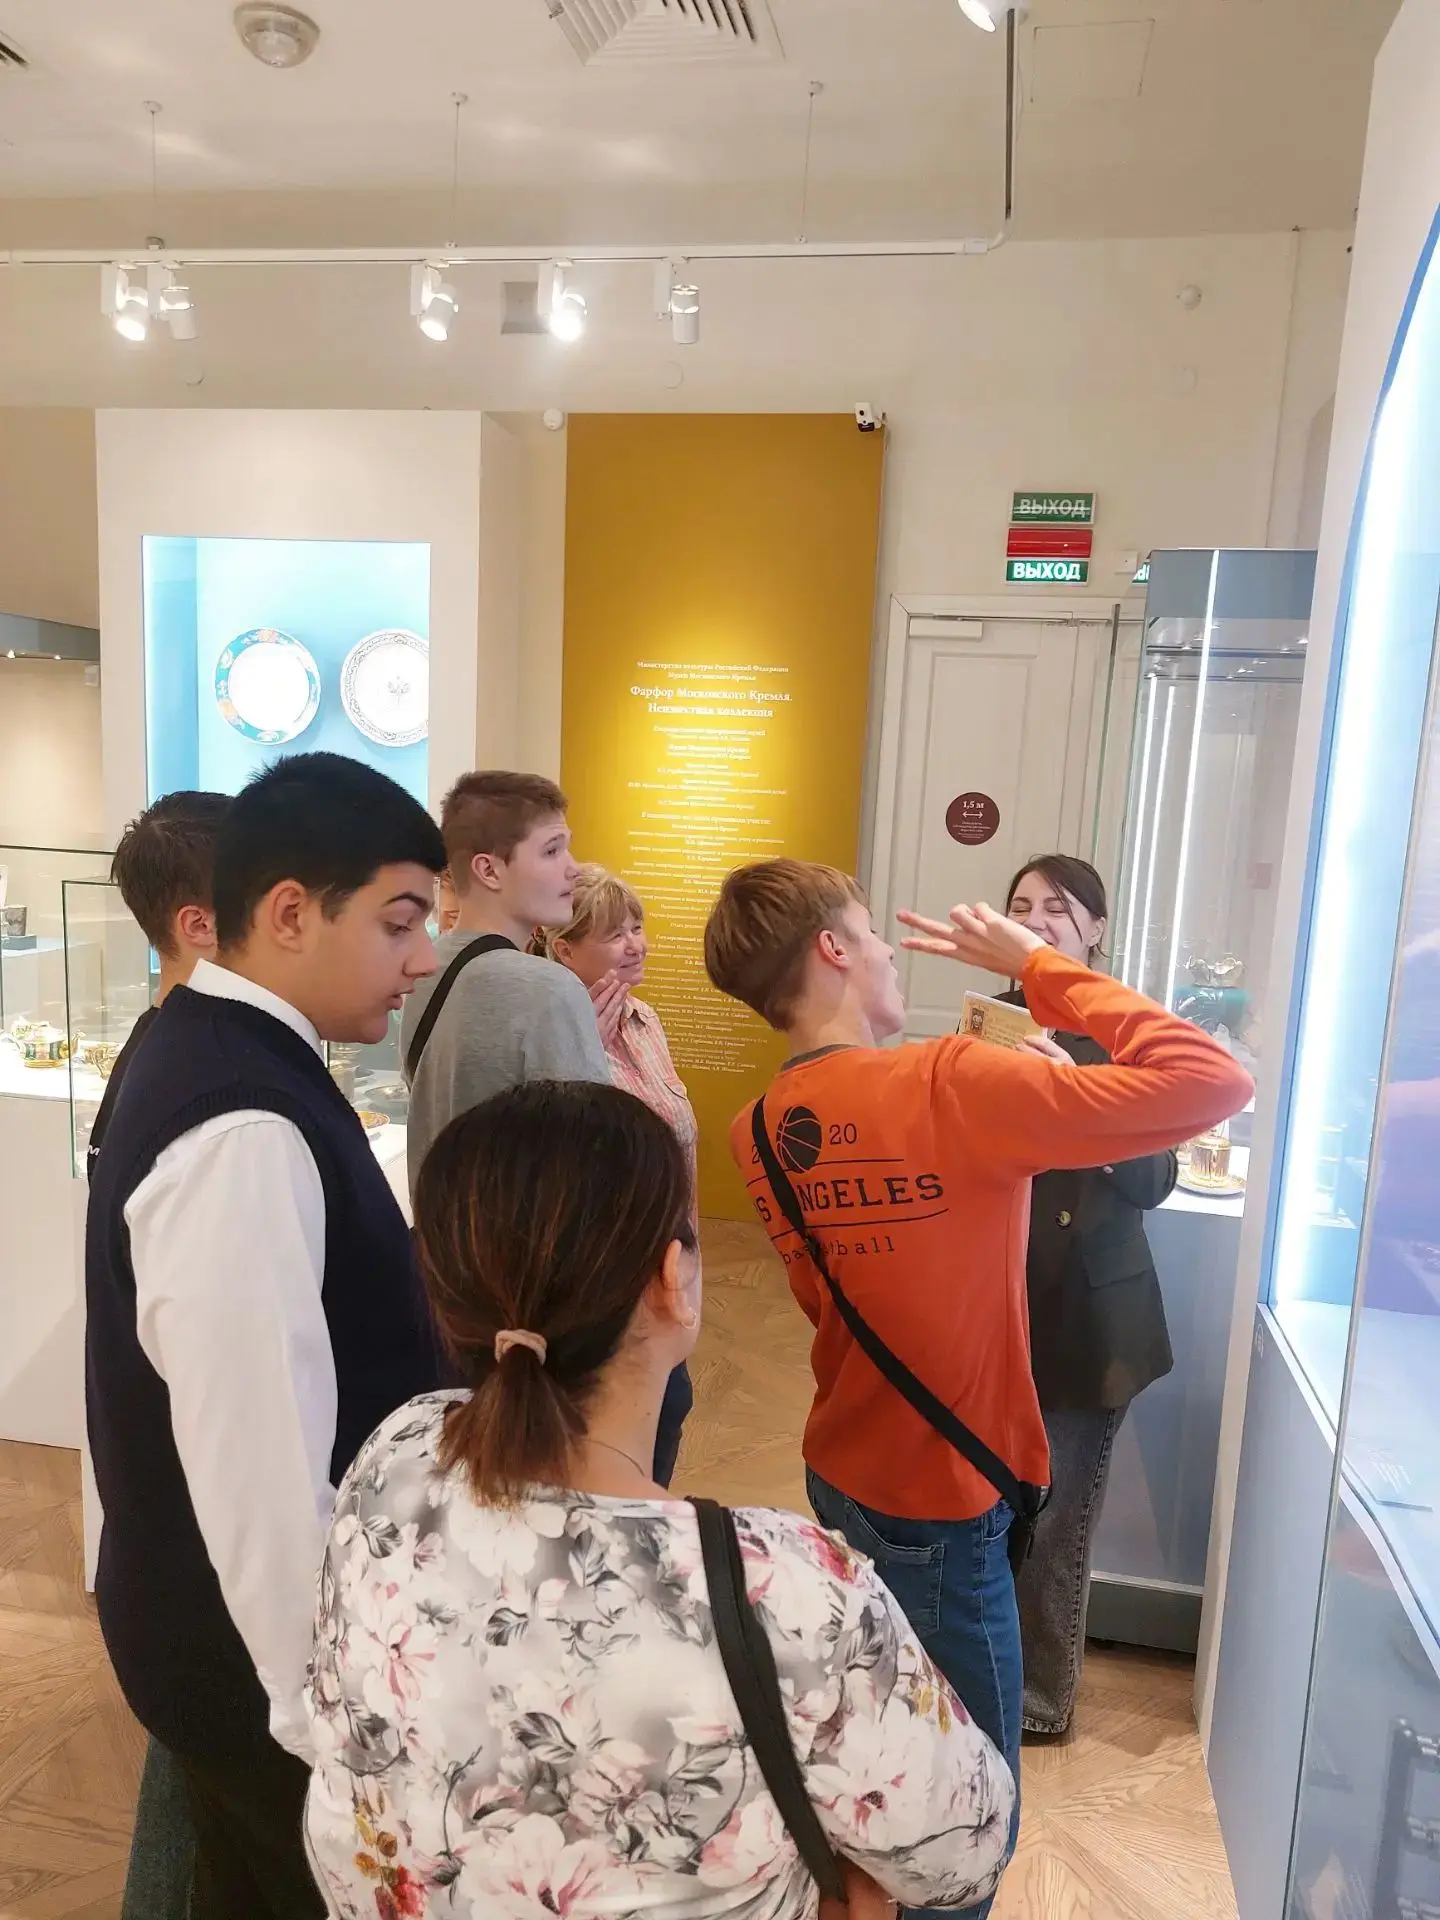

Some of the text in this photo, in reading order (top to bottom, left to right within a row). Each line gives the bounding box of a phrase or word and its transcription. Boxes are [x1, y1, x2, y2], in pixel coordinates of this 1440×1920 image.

[1019, 498, 1086, 518] ВЫХОД
[1012, 562, 1081, 580] ВЫХОД
[630, 686, 674, 699] Фарфор
[963, 801, 975, 809] 1,5
[829, 1123, 858, 1145] 20
[782, 1173, 944, 1216] NGELES
